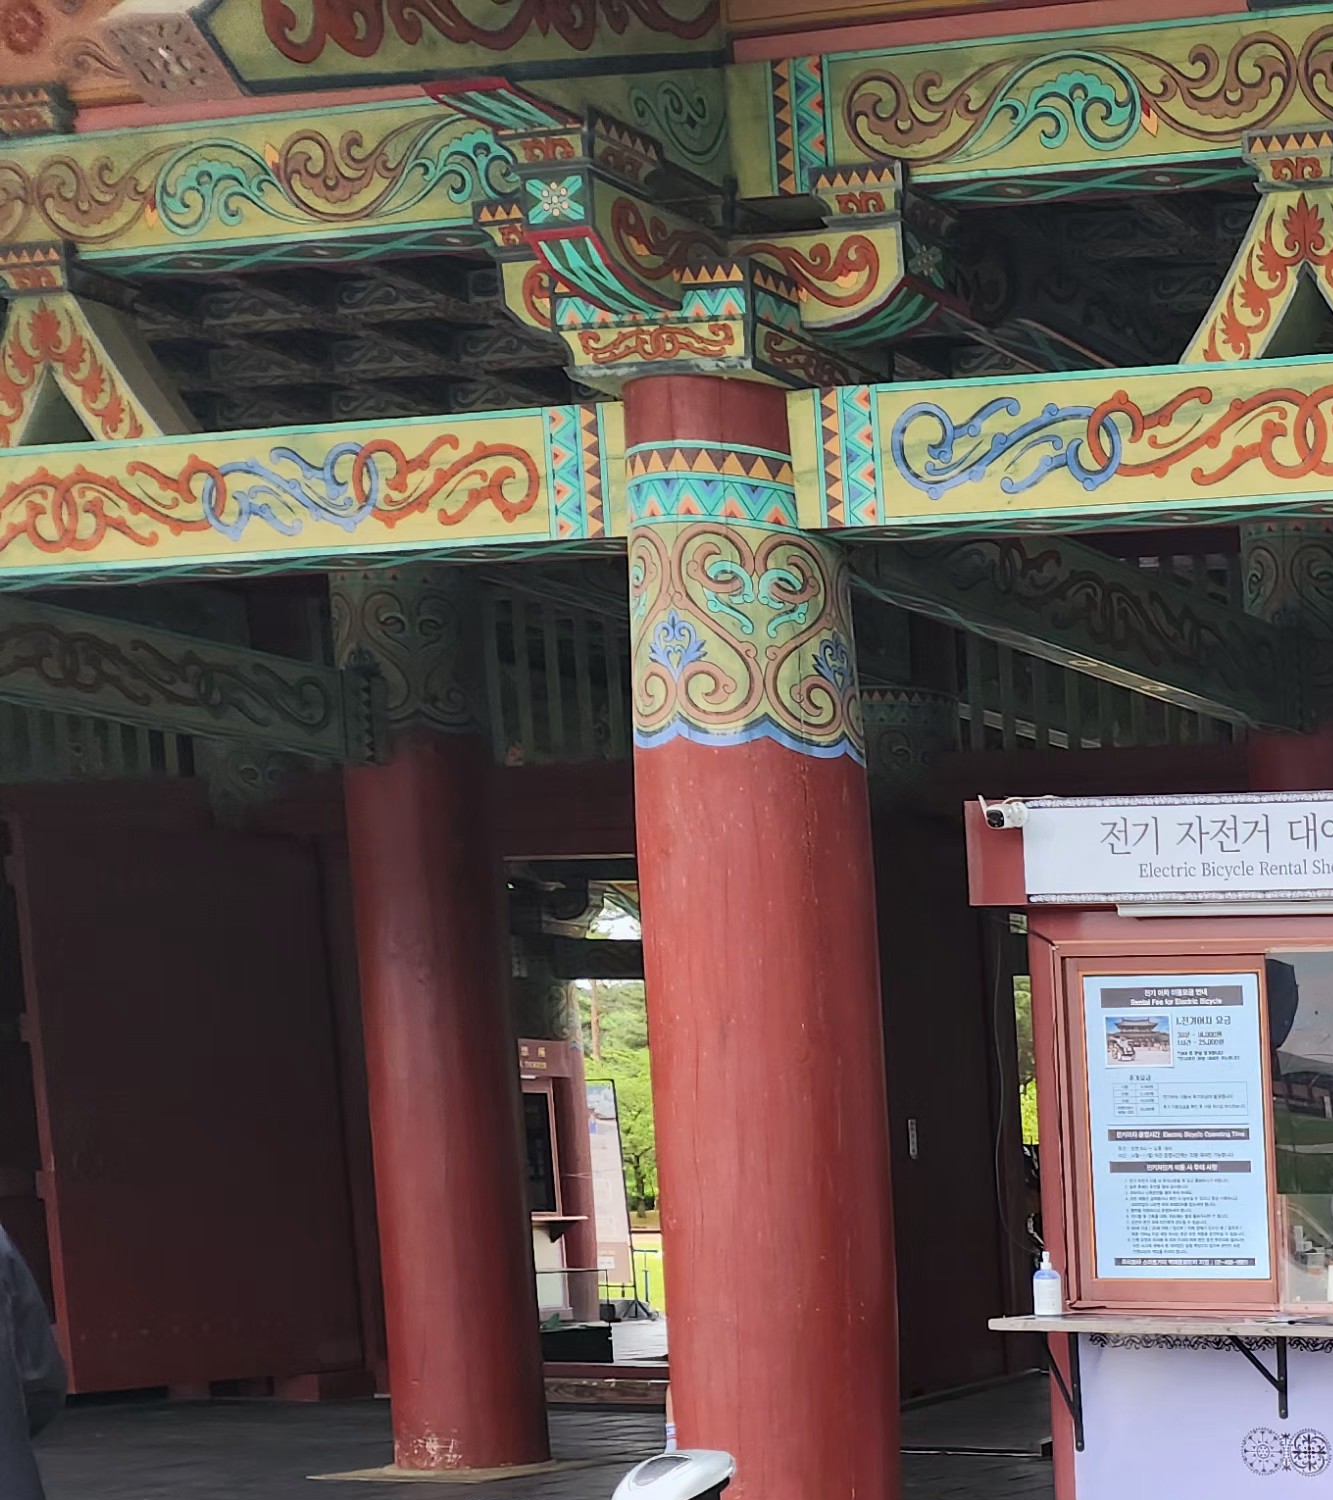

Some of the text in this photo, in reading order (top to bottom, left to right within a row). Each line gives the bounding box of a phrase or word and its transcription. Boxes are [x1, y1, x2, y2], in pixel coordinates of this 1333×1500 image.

[1100, 815, 1160, 856] 전기
[1176, 813, 1270, 855] 자전거
[1138, 861, 1197, 879] Electric
[1201, 860, 1253, 880] Bicycle
[1259, 859, 1307, 875] Rental
